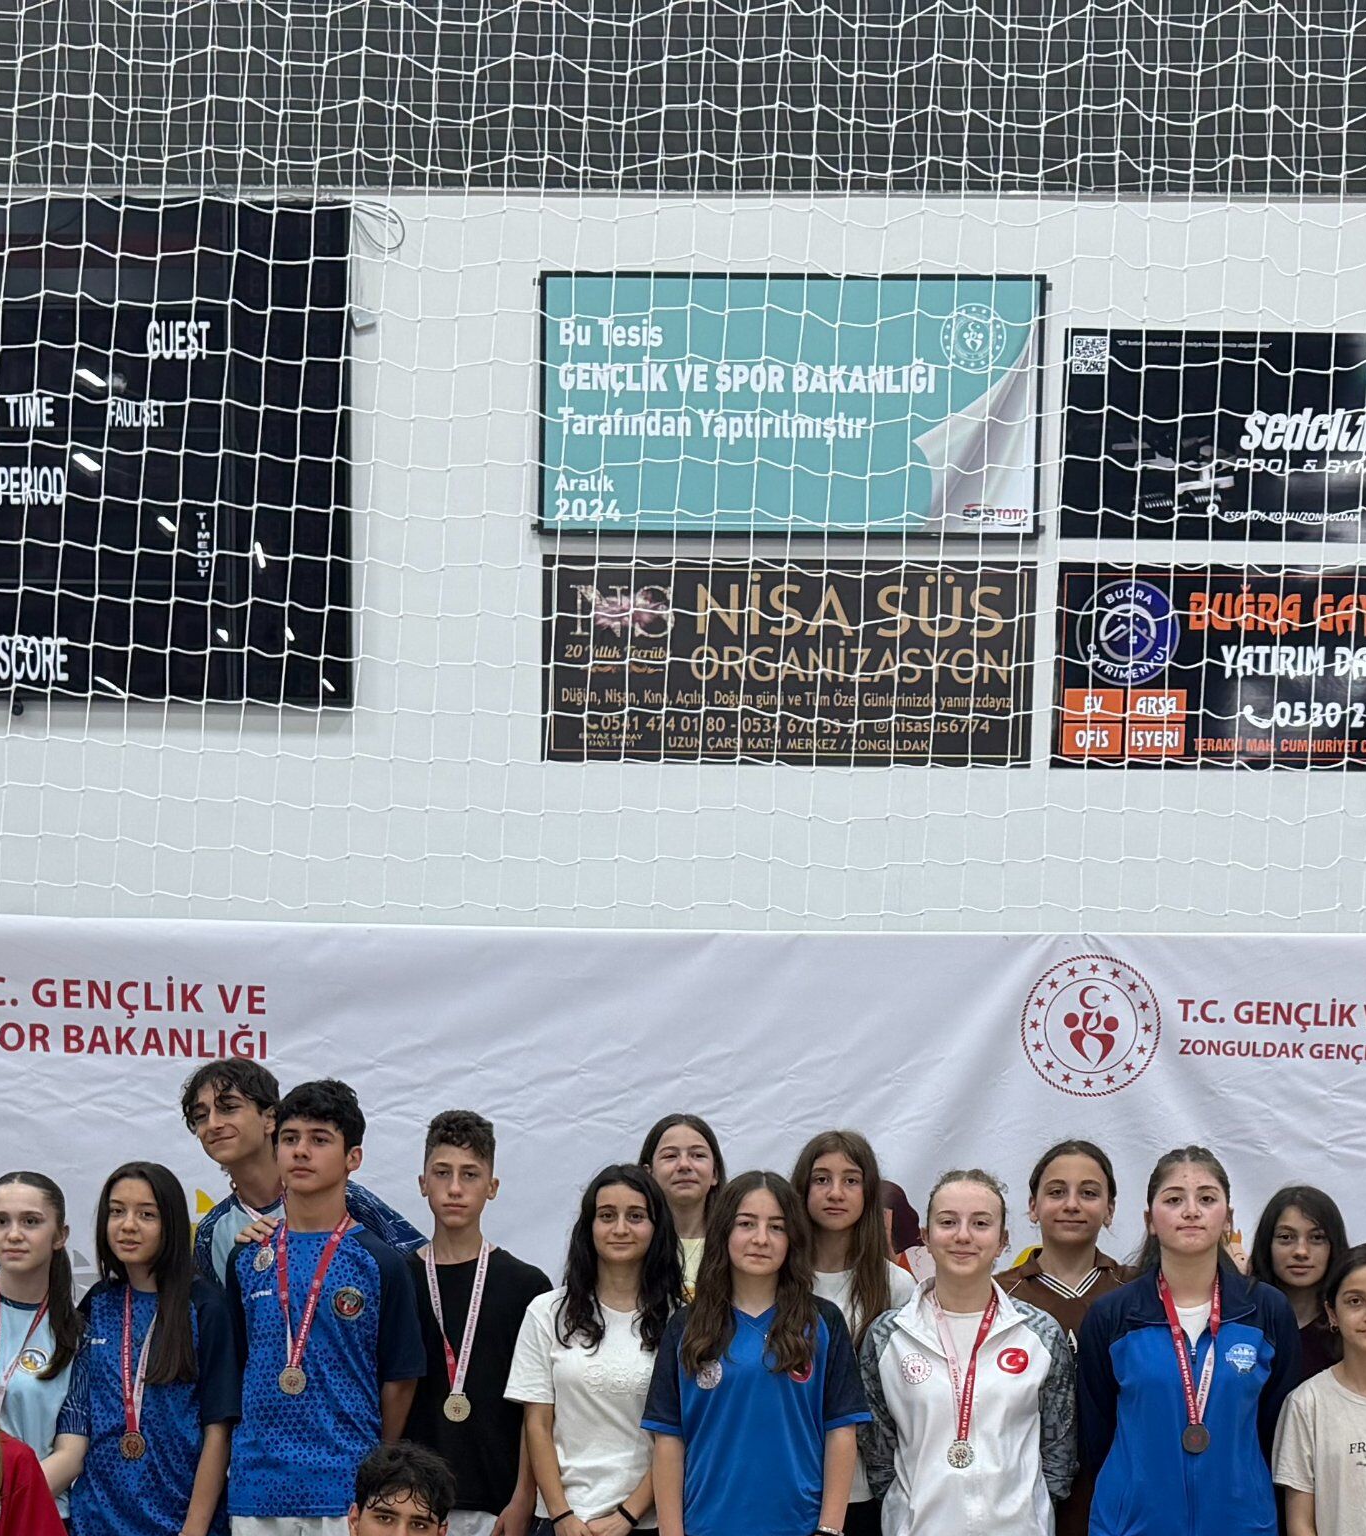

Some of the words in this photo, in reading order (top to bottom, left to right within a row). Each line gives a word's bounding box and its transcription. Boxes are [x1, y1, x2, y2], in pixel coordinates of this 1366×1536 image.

[147, 321, 210, 360] GUEST
[559, 319, 591, 346] Bu
[598, 318, 663, 347] Tesis
[558, 356, 668, 397] GENÇLİK
[674, 363, 708, 392] VE
[715, 364, 784, 393] SPOR
[793, 358, 935, 394] BAKANLIĞI
[5, 397, 55, 428] TIME
[108, 400, 165, 428] FAUL/SET
[558, 406, 691, 436] Tarafından
[698, 408, 868, 445] Yaptırılmıştır
[555, 474, 614, 492] Aralık
[555, 499, 621, 522] 2024
[695, 574, 855, 638] NİSA
[876, 575, 1005, 638] SÜS
[1188, 583, 1302, 637] BUĞRA
[690, 640, 1012, 684] ORGANİZASYON
[1221, 645, 1325, 679] YATIRIM
[788, 695, 802, 706] ve
[834, 689, 857, 706] Öze
[601, 715, 639, 731] 0541
[646, 716, 675, 731] 474
[706, 717, 726, 732] 80
[1275, 702, 1341, 728] 0530
[1075, 727, 1110, 748] OFİS
[1131, 727, 1180, 752] İŞYERİ
[32, 976, 202, 1019] GENÇLİK
[218, 984, 266, 1015] VE
[1177, 999, 1225, 1025] T.C.
[1234, 997, 1356, 1033] GENÇLİK
[63, 1023, 267, 1060] BAKANLIĞI
[1179, 1039, 1305, 1060] ZONGULDAK
